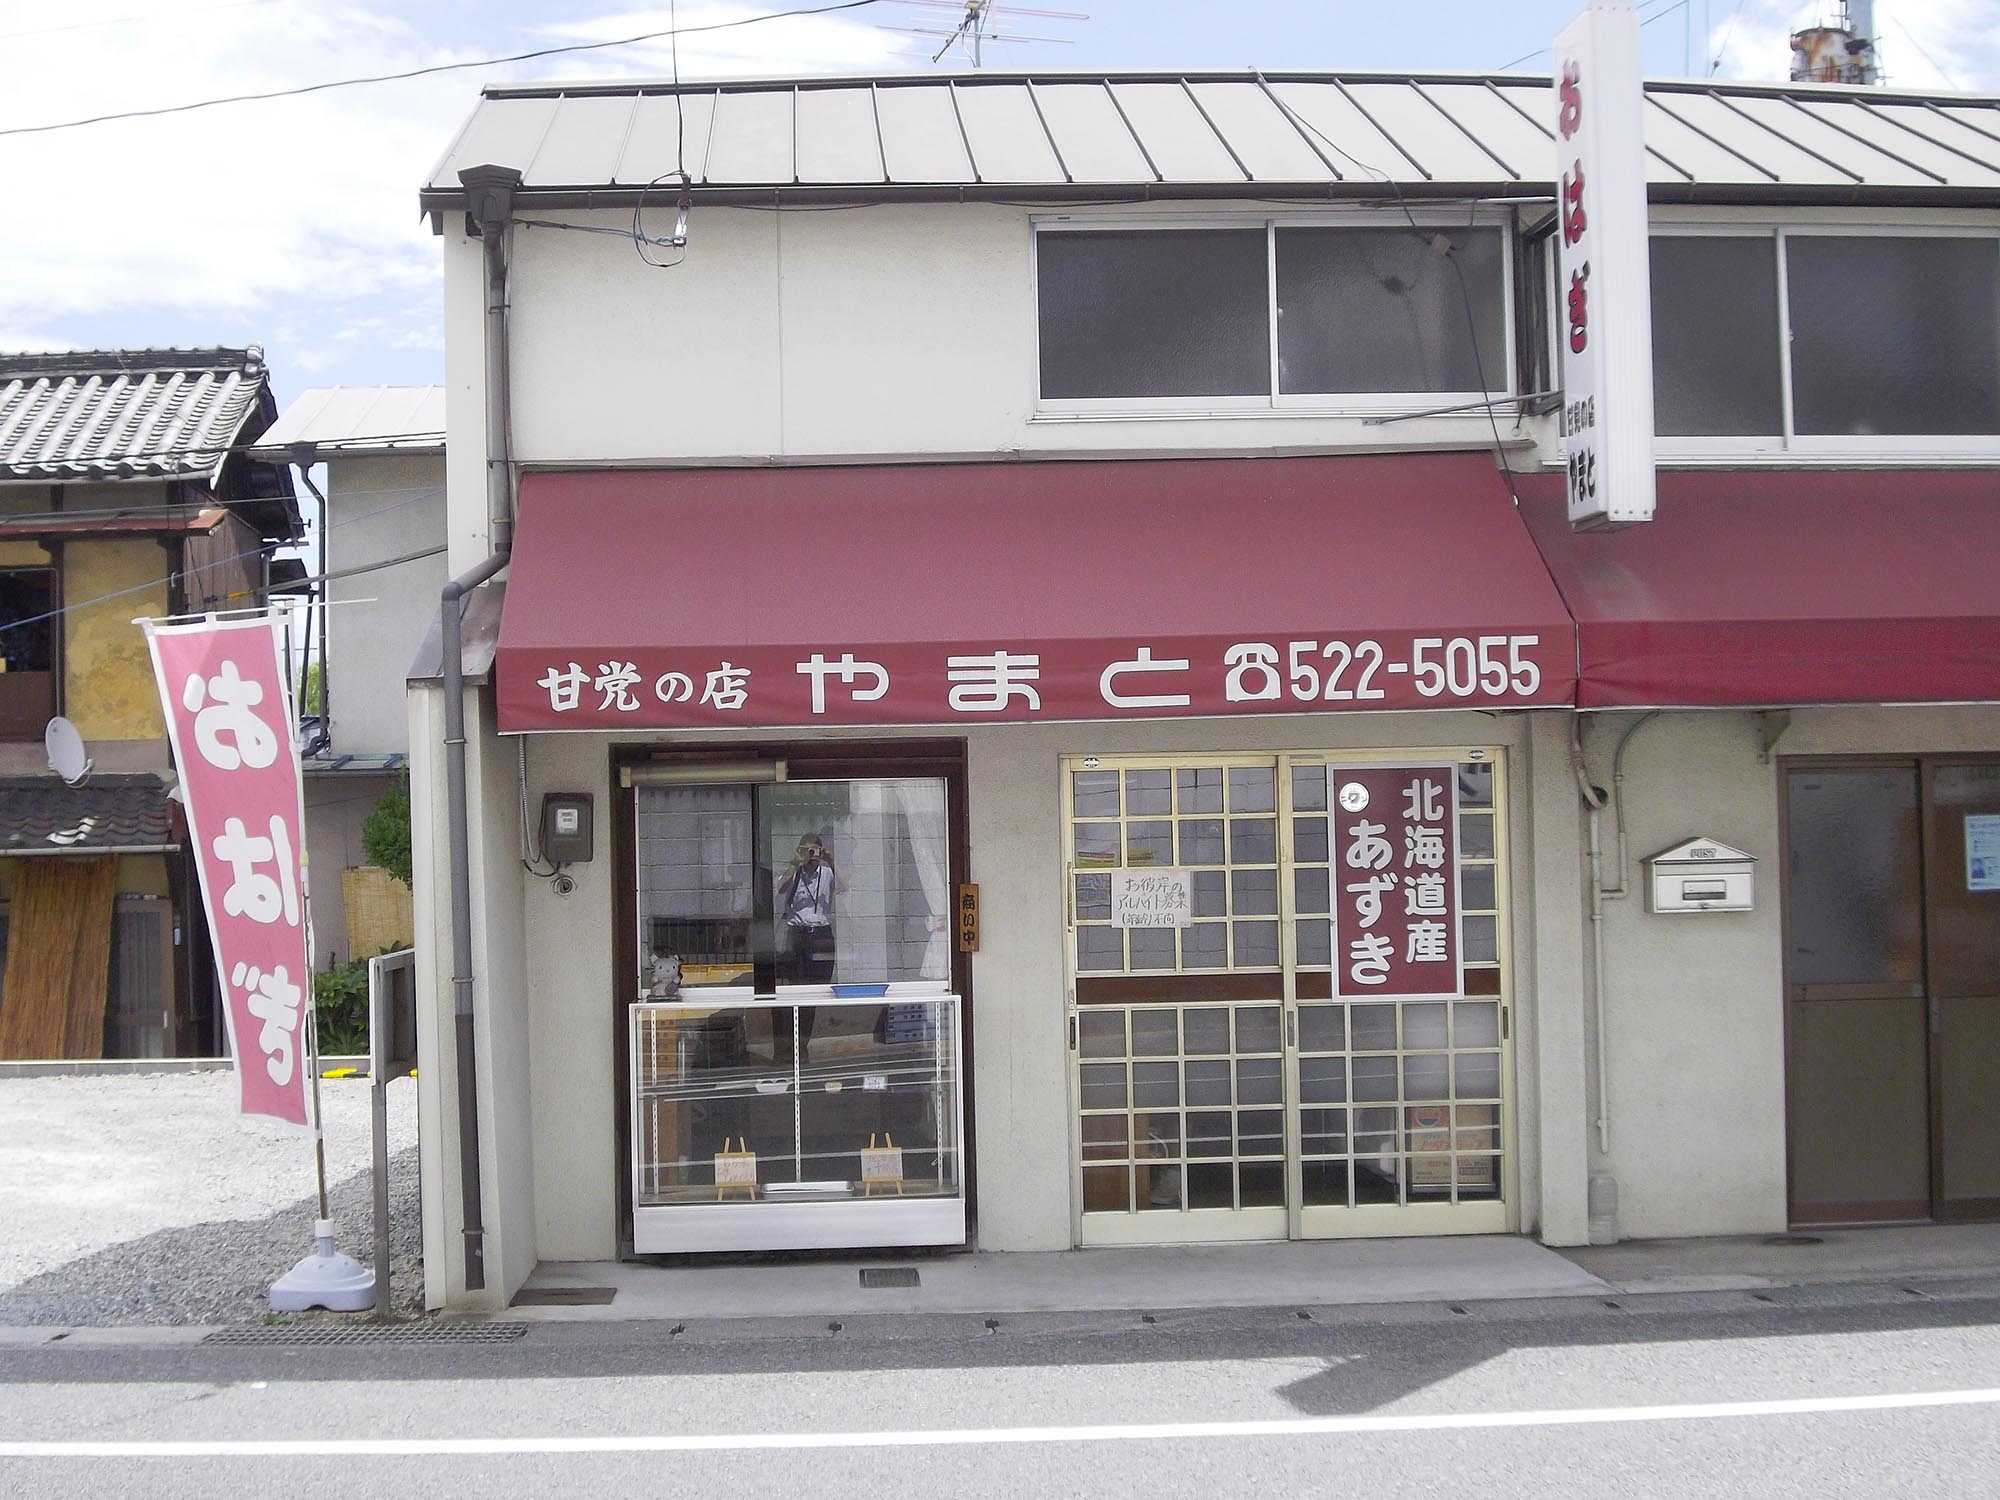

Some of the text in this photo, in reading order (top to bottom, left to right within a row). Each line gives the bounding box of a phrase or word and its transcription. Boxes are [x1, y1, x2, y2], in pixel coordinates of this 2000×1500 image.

[1560, 58, 1591, 354] おはぎ
[1570, 446, 1595, 504] やまと
[537, 634, 1541, 714] 甘党の店 やまと 522-5055
[1402, 778, 1449, 964] 北海道産
[1690, 847, 1717, 858] POST
[962, 893, 975, 945] 商い中
[1346, 818, 1399, 985] あずき
